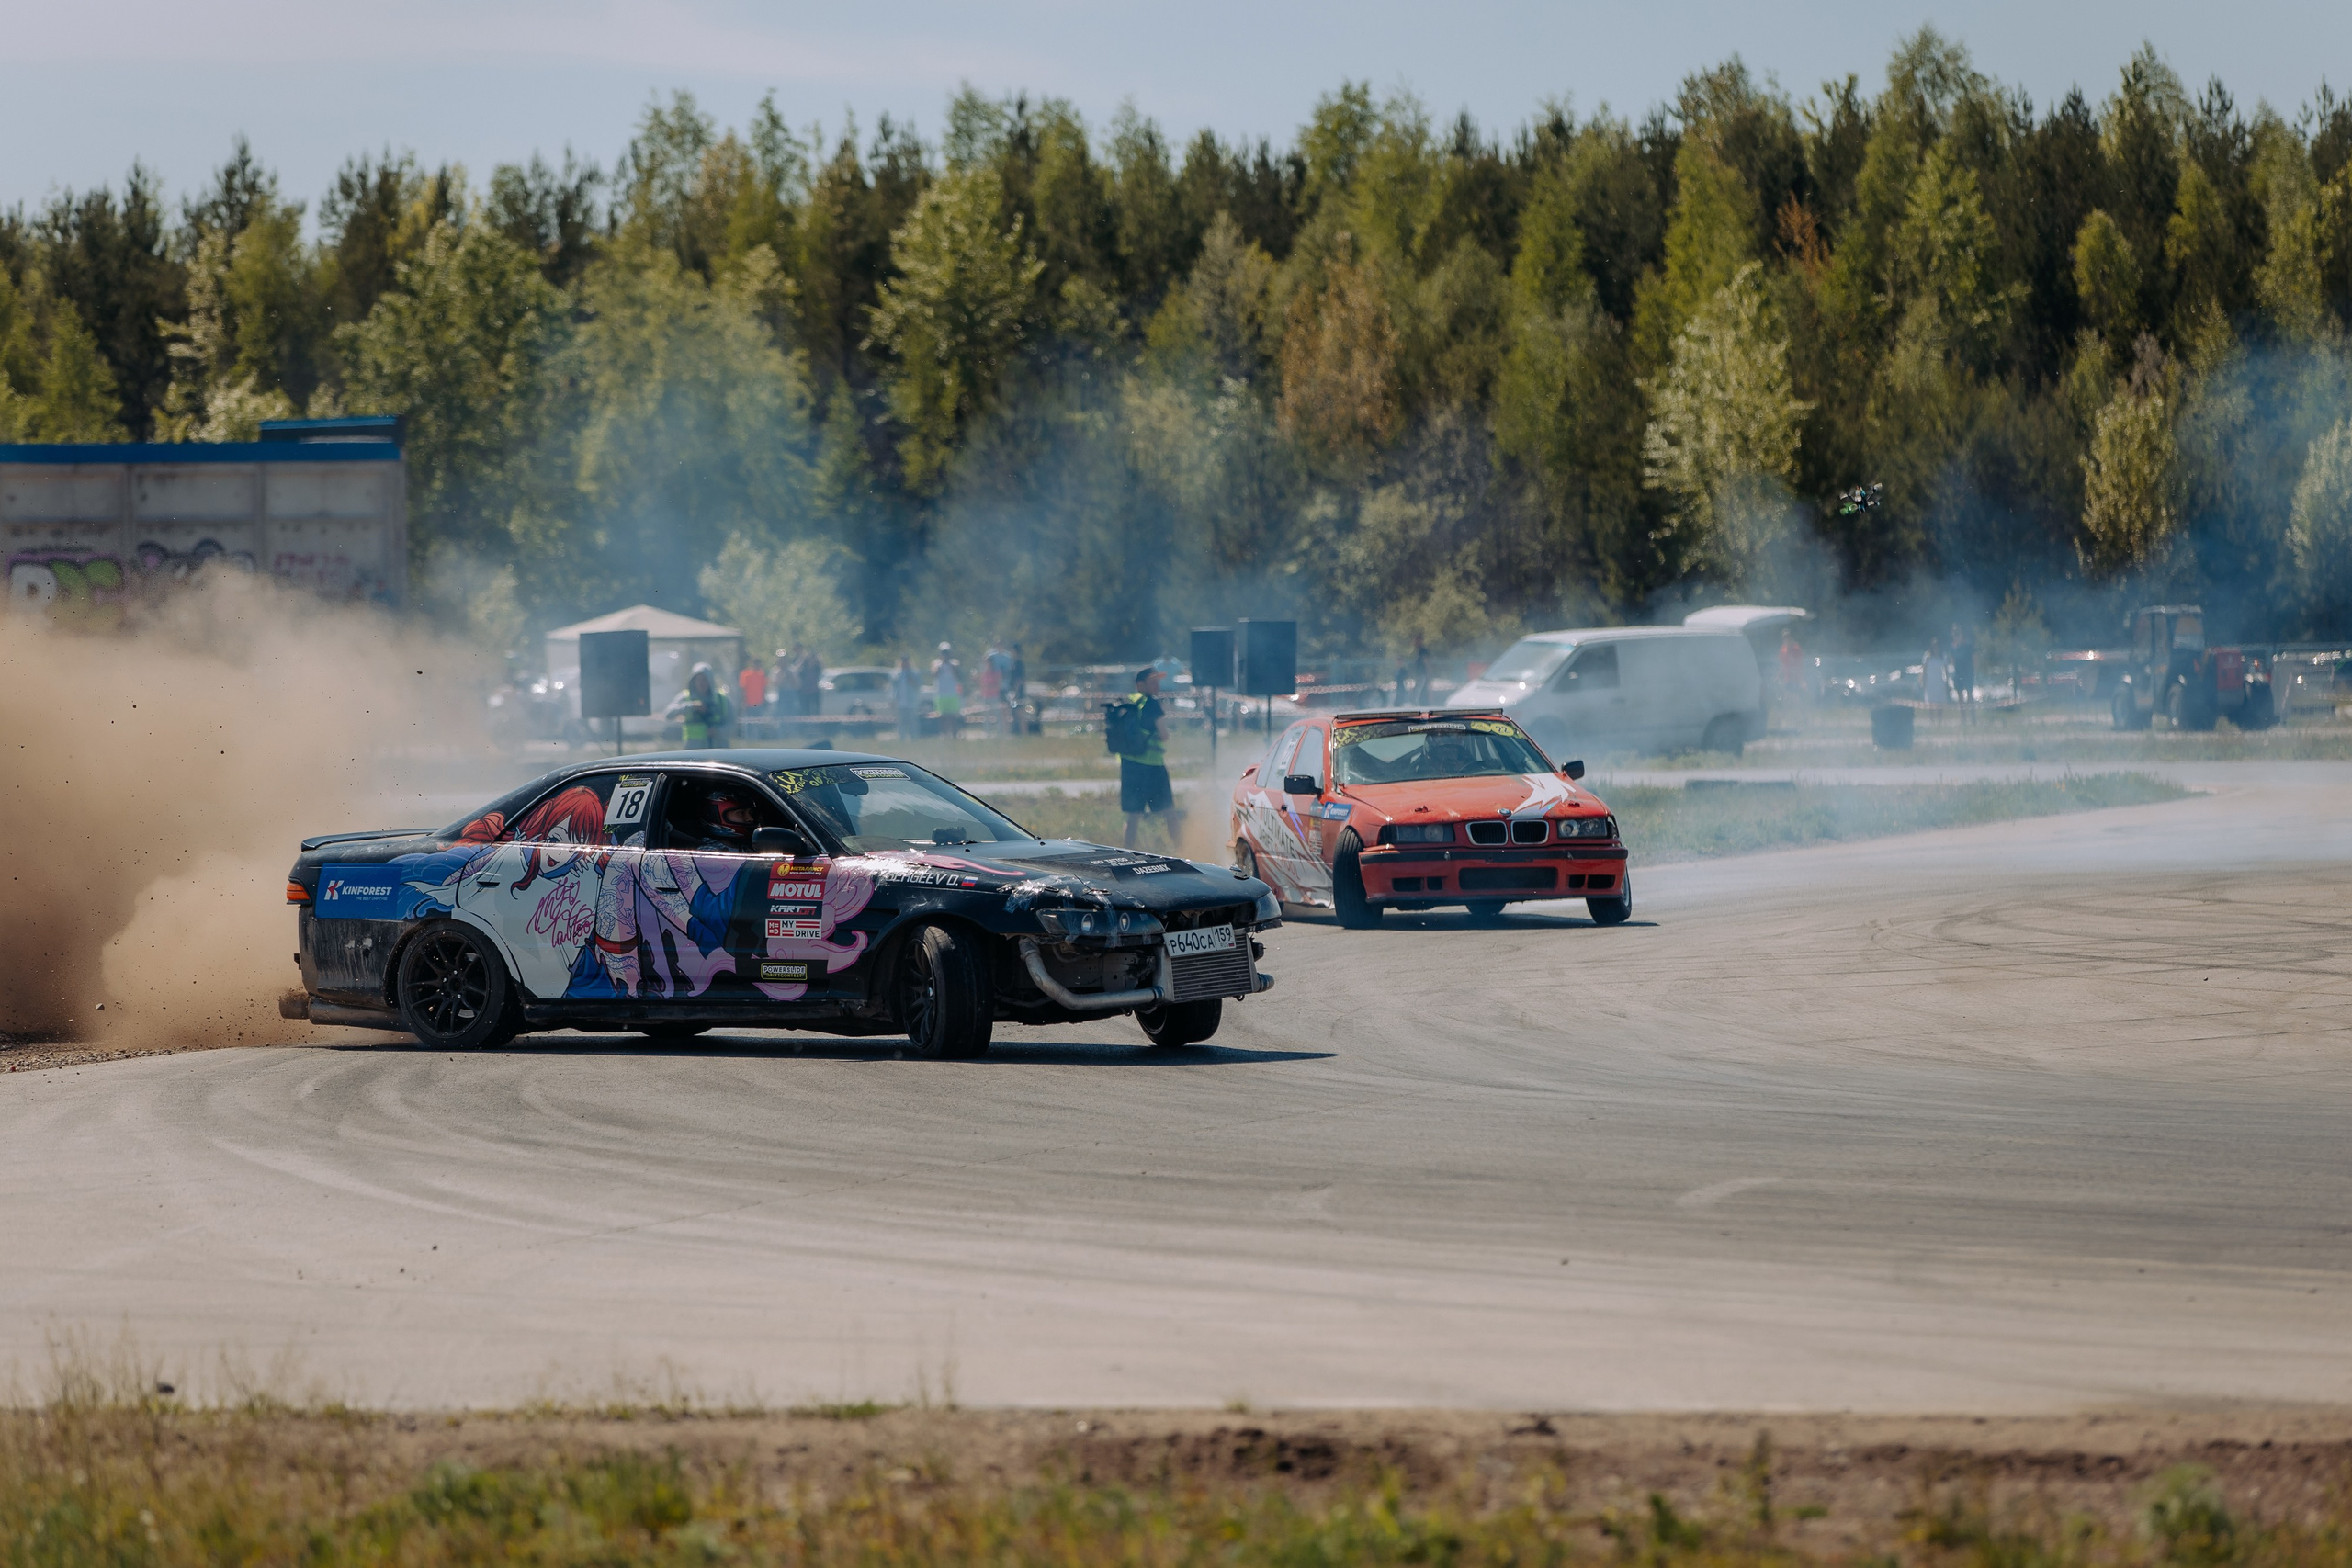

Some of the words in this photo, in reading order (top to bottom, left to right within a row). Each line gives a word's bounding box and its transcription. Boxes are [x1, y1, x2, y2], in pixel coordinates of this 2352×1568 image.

[616, 790, 645, 818] 18
[342, 886, 392, 896] KINFOREST
[770, 883, 822, 897] MOTUL
[1215, 927, 1231, 942] 159
